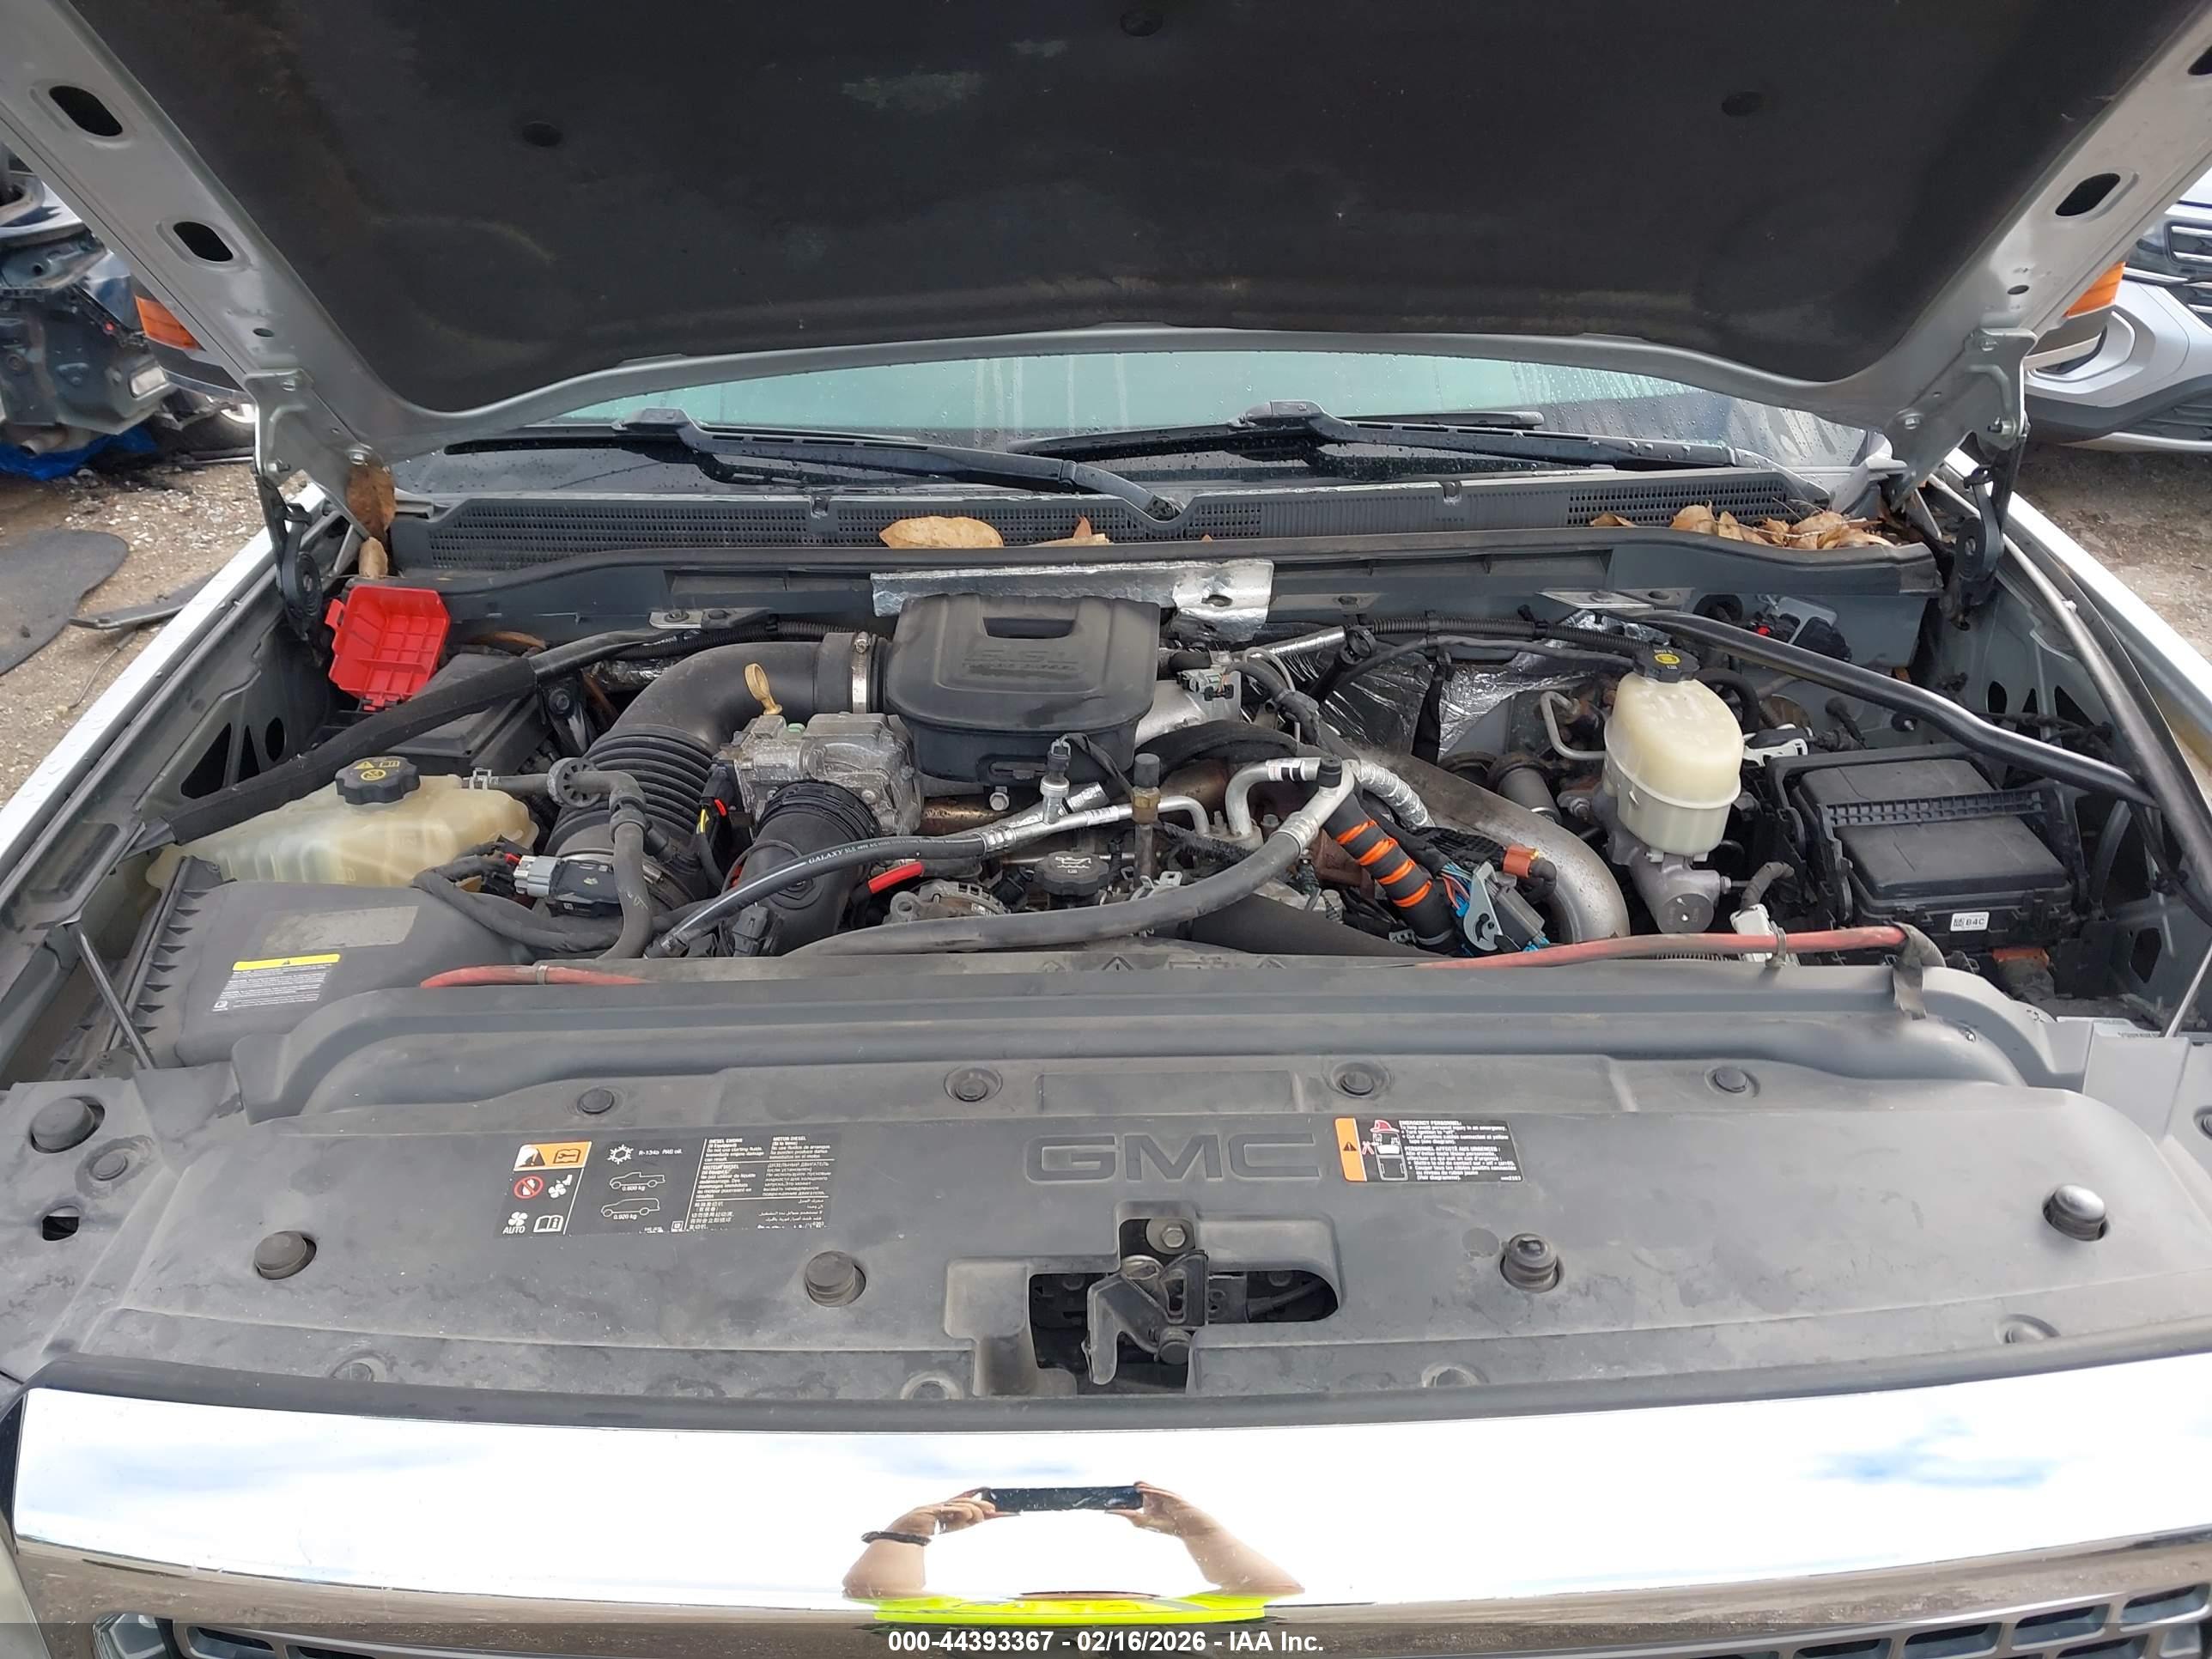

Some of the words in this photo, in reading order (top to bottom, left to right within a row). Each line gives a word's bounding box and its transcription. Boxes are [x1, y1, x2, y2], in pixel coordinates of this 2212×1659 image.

[808, 848, 842, 864] GALAXY
[1025, 1133, 1322, 1184] GMC
[502, 1225, 526, 1234] AUTO
